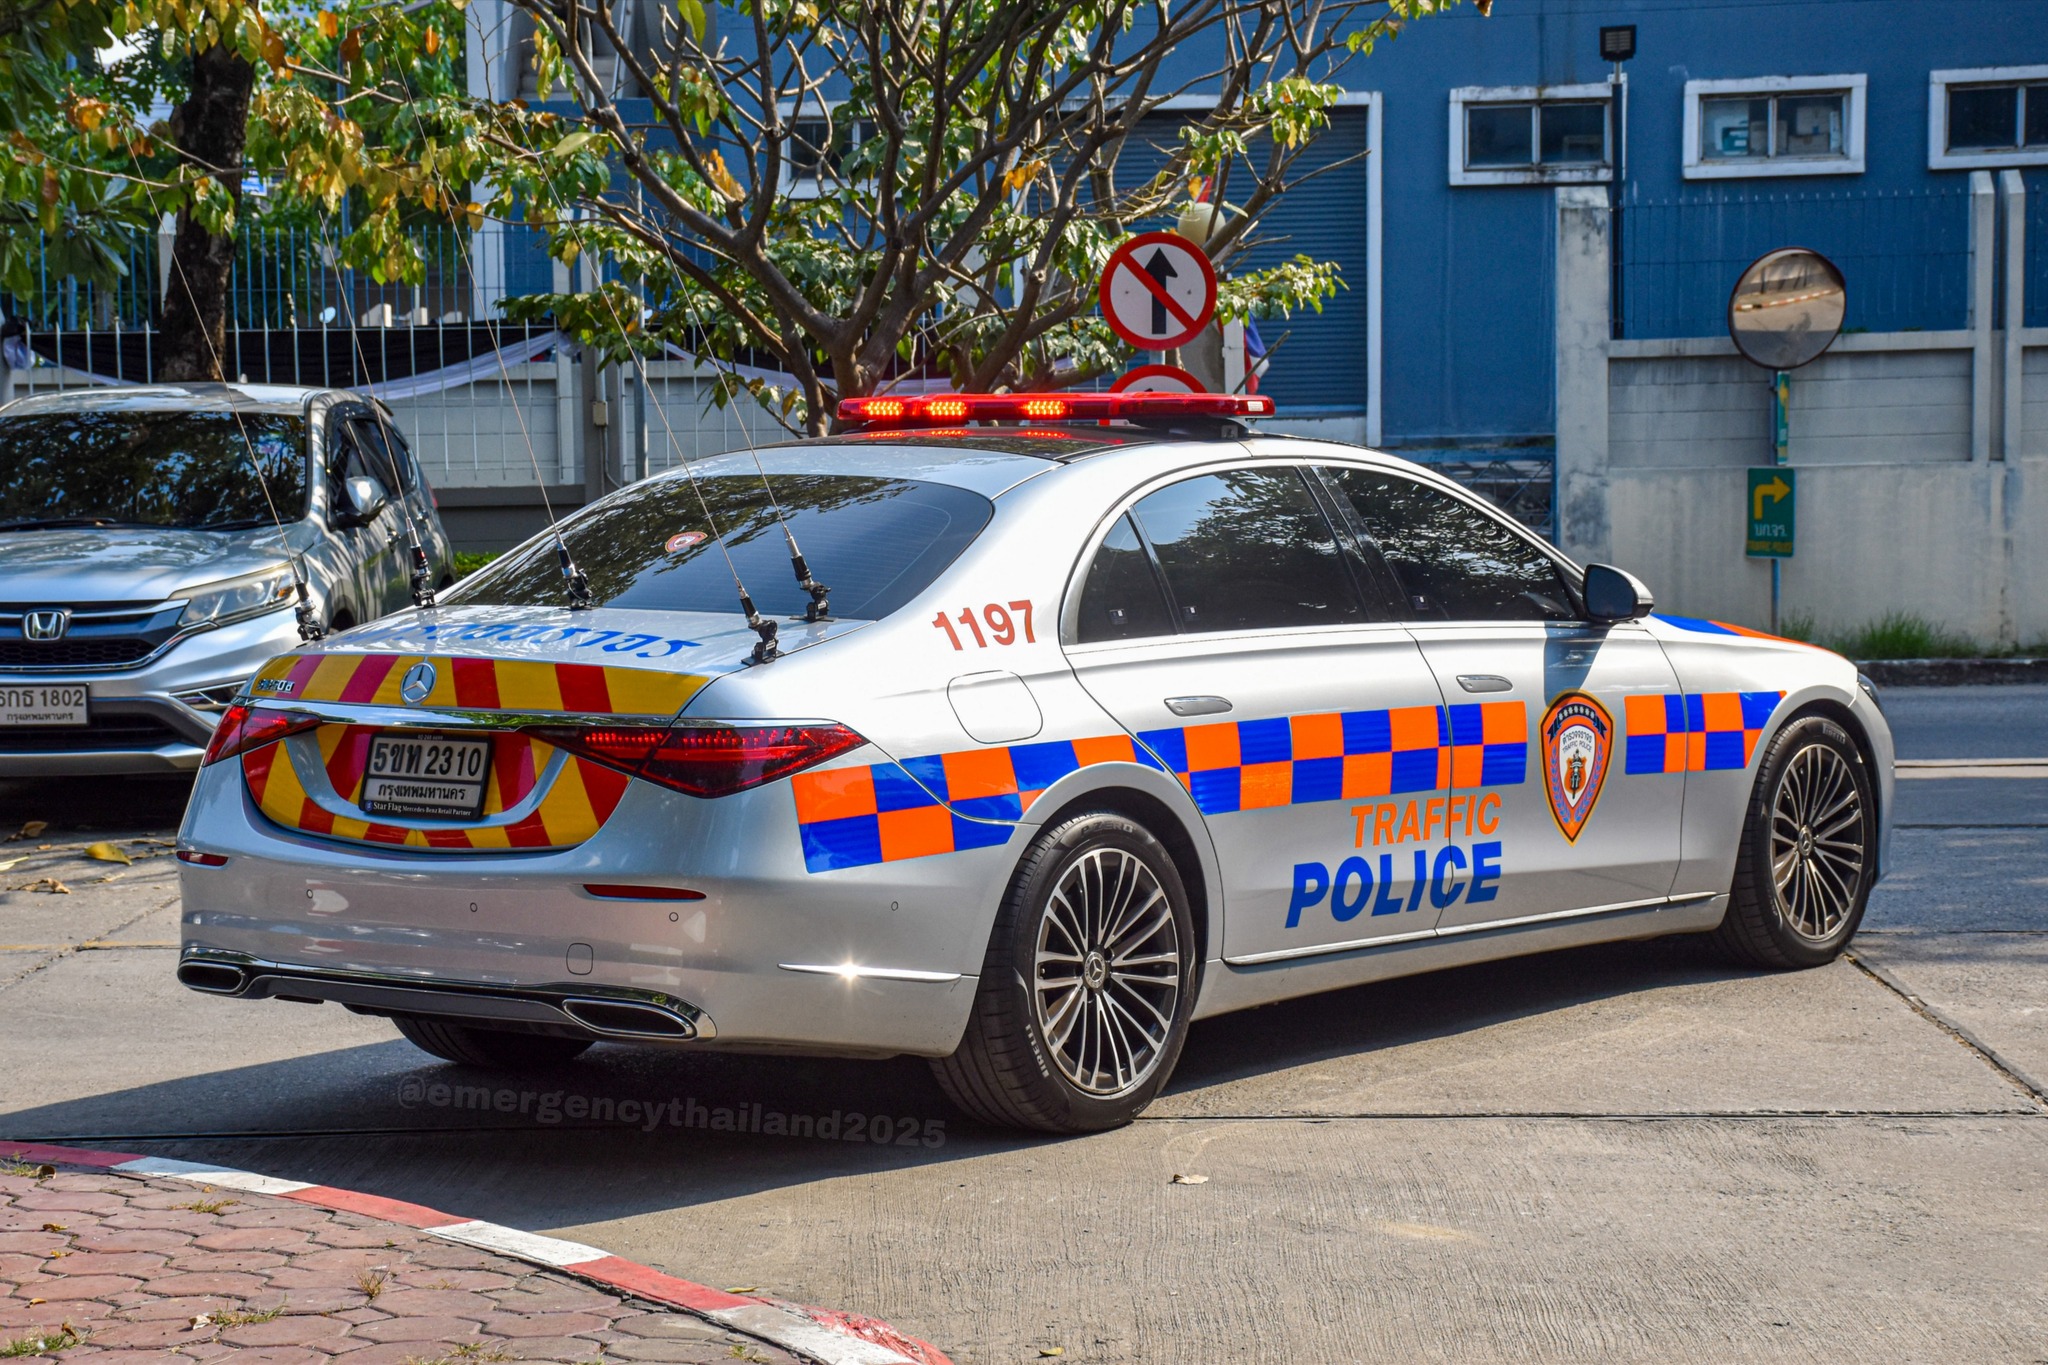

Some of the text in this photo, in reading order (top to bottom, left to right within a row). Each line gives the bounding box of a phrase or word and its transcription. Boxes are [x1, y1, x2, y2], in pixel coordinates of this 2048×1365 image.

[932, 600, 1036, 651] 1197
[40, 689, 84, 707] 1802
[6, 712, 74, 723] กรุงเทพมหานคร
[1562, 740, 1593, 753] TRAFFIC POLICE
[373, 743, 482, 777] 5ขท 2310
[378, 784, 466, 801] กรุงเทพมหานคร
[373, 801, 472, 816] Star Flag Mercedes-Benz Retail Partner
[1350, 792, 1502, 849] TRAFFIC
[1284, 841, 1502, 929] POLICE
